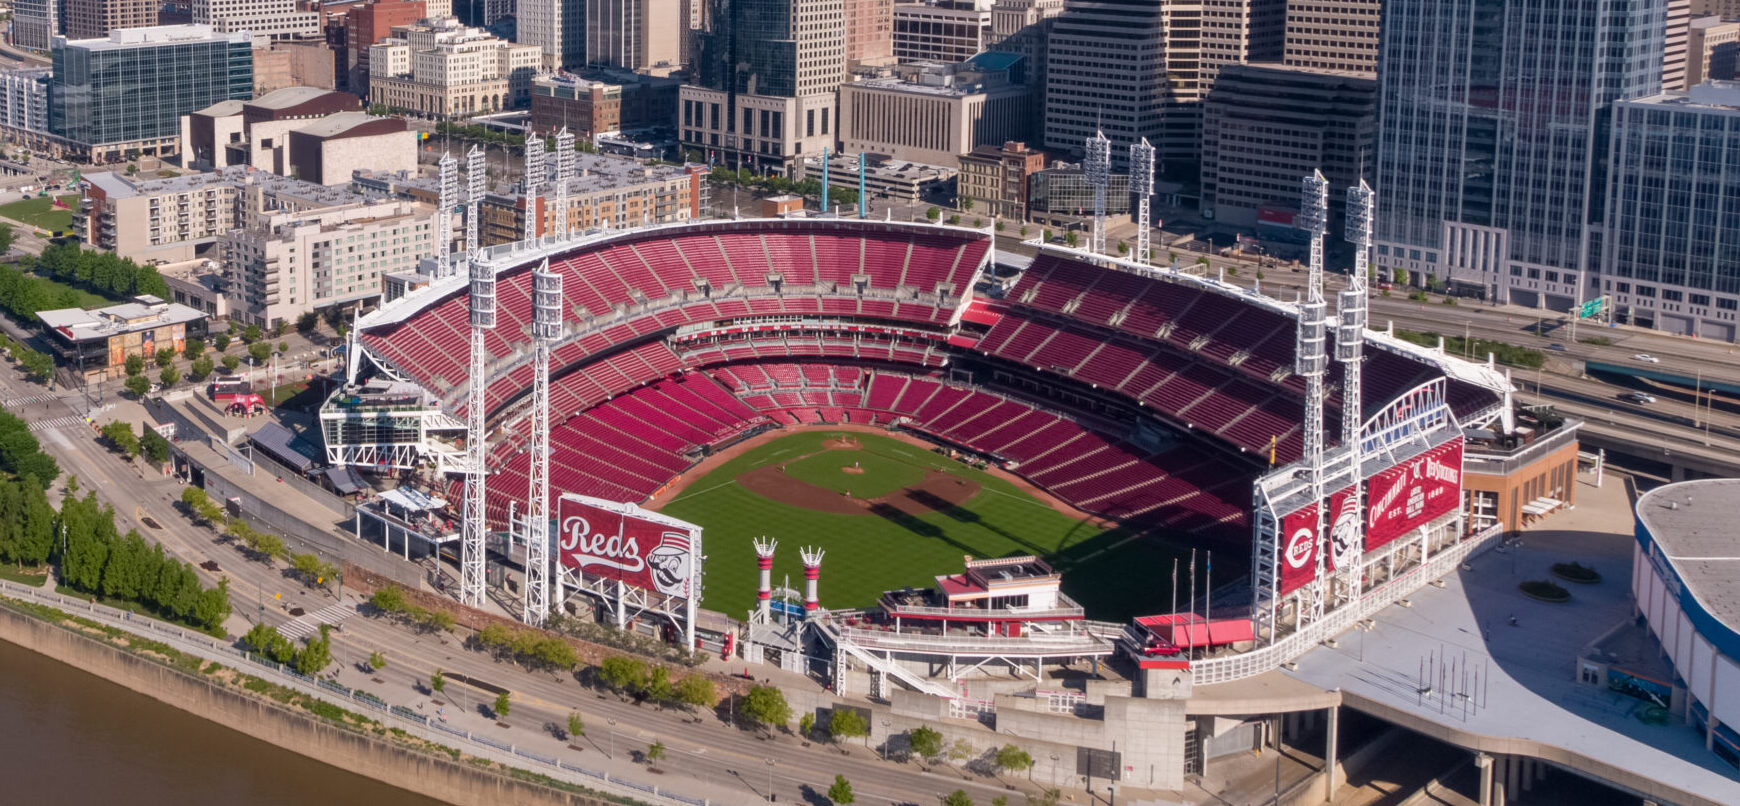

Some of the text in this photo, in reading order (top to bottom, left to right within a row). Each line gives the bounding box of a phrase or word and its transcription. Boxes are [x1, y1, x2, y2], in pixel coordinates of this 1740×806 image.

[1369, 471, 1407, 529] CINCINNATI
[560, 516, 644, 572] Reds
[1293, 538, 1313, 556] REDS
